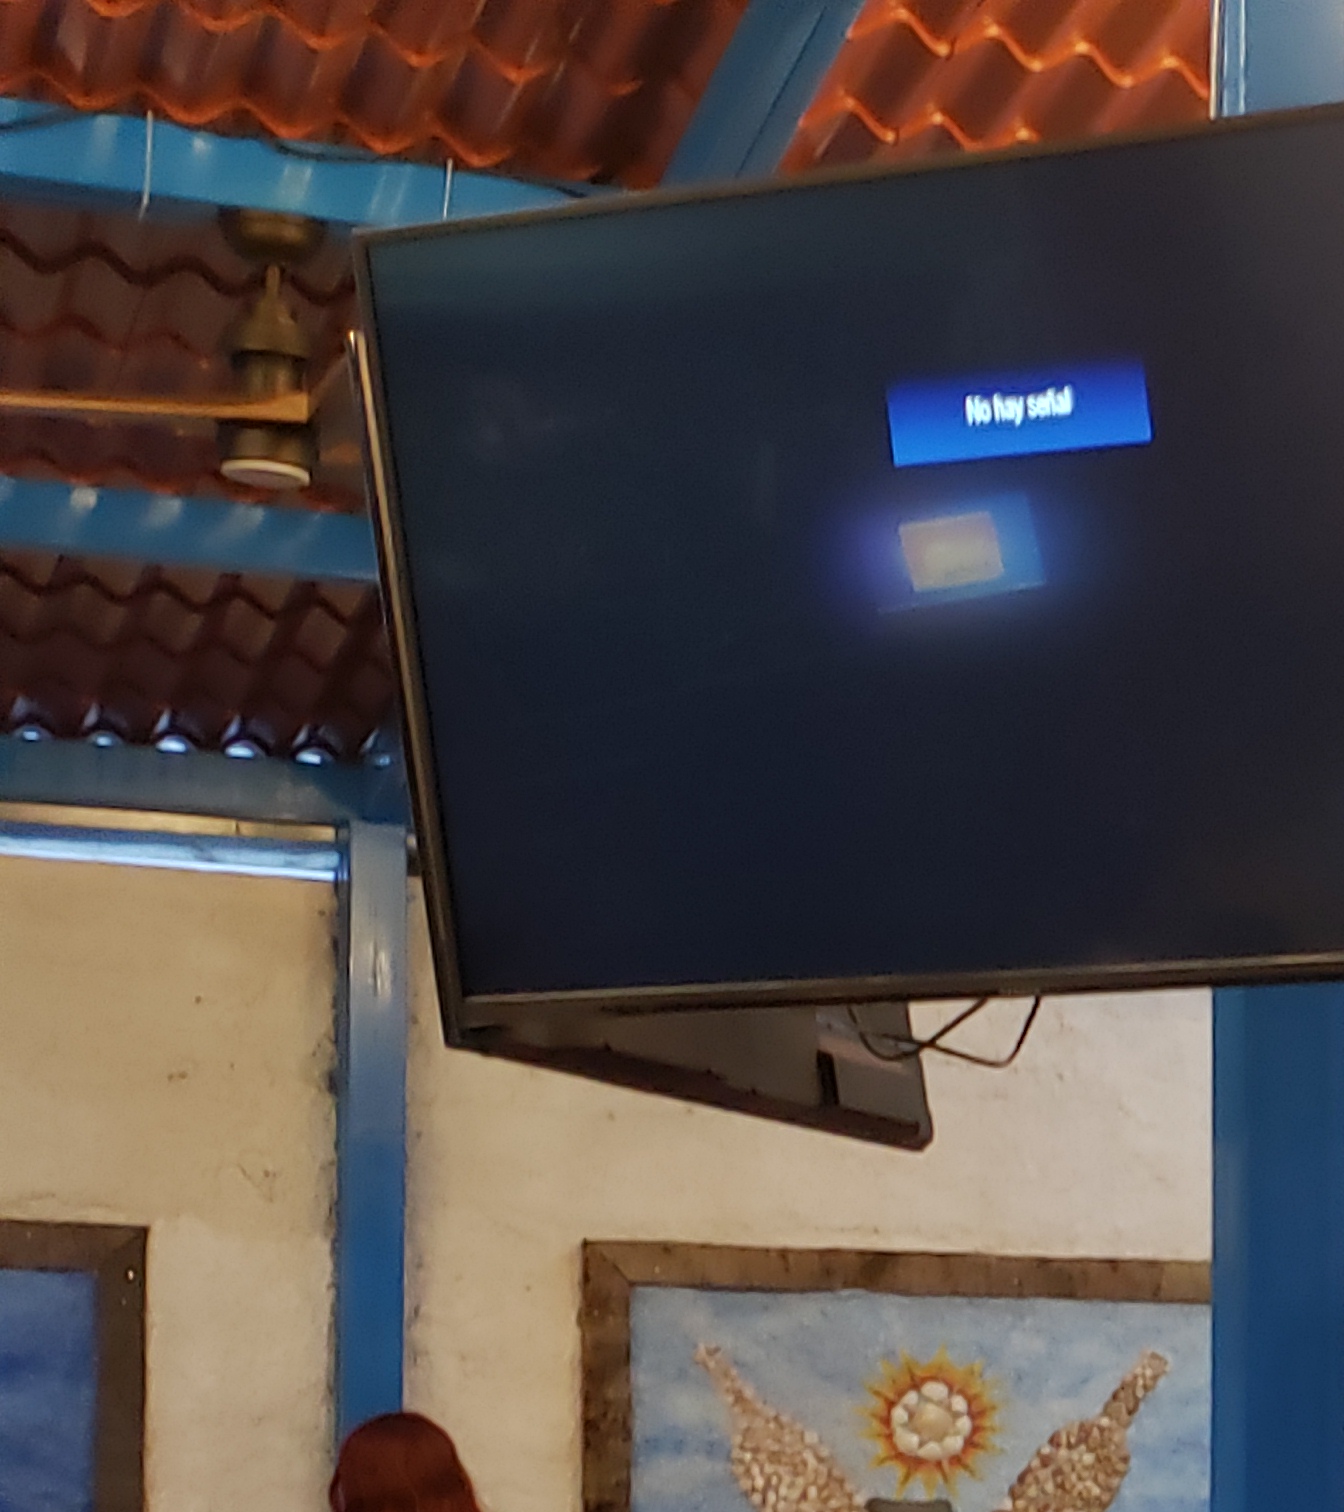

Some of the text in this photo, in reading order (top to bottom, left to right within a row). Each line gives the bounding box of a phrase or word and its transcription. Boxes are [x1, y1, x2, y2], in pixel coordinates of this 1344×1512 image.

[964, 384, 1074, 428] No hay señal
